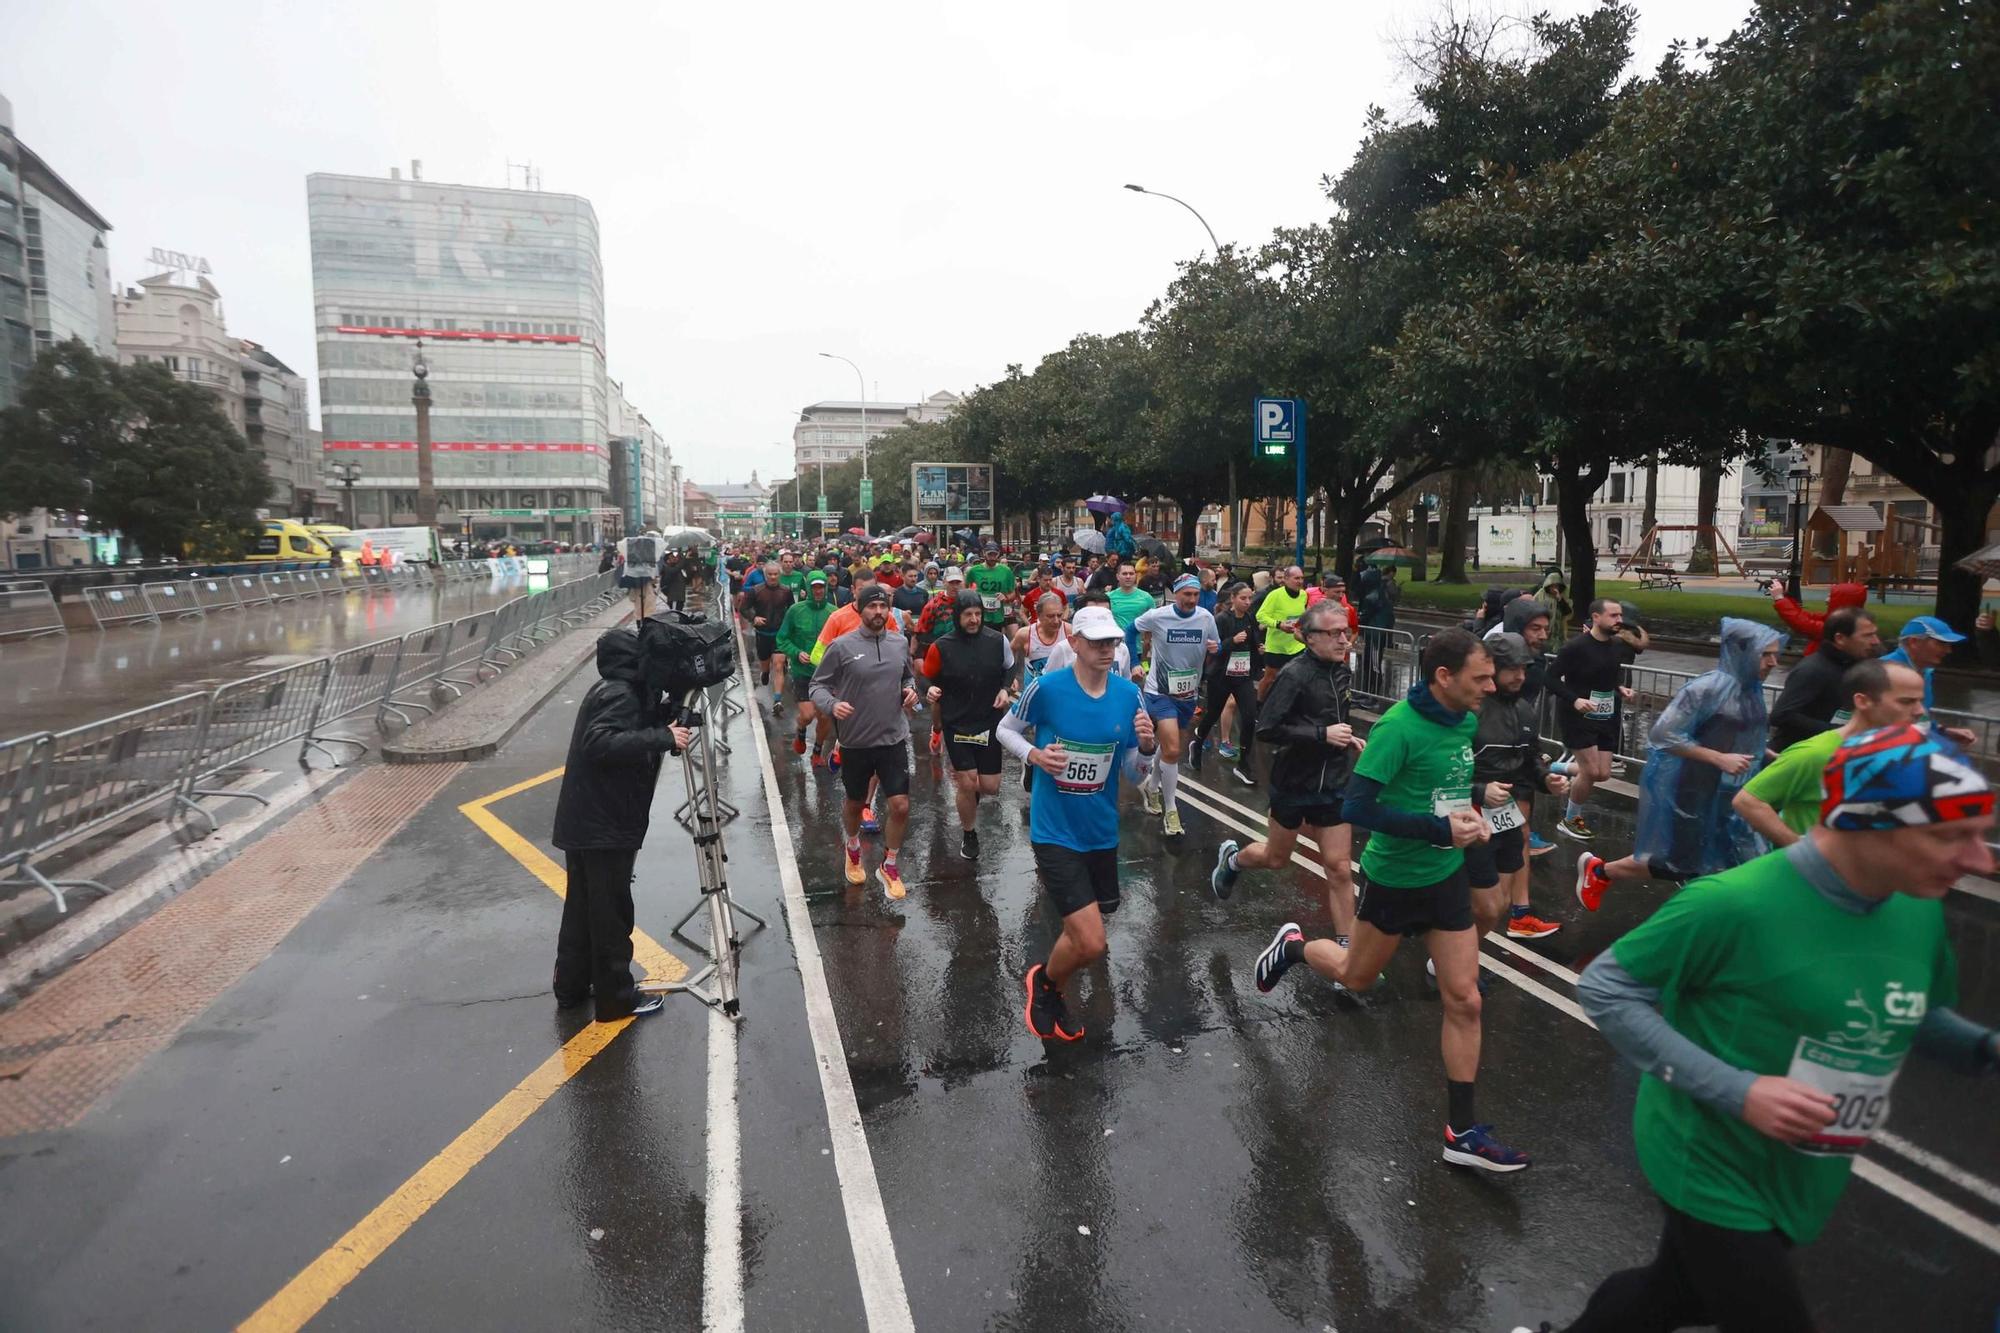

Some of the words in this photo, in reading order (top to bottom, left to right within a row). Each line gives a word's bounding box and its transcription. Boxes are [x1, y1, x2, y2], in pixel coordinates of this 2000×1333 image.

[151, 246, 212, 275] BBVA
[1262, 403, 1284, 438] P
[393, 492, 572, 509] MANGO
[918, 488, 946, 498] PLAN
[1177, 681, 1191, 692] 931
[1067, 761, 1098, 781] 565
[1492, 811, 1516, 831] 845
